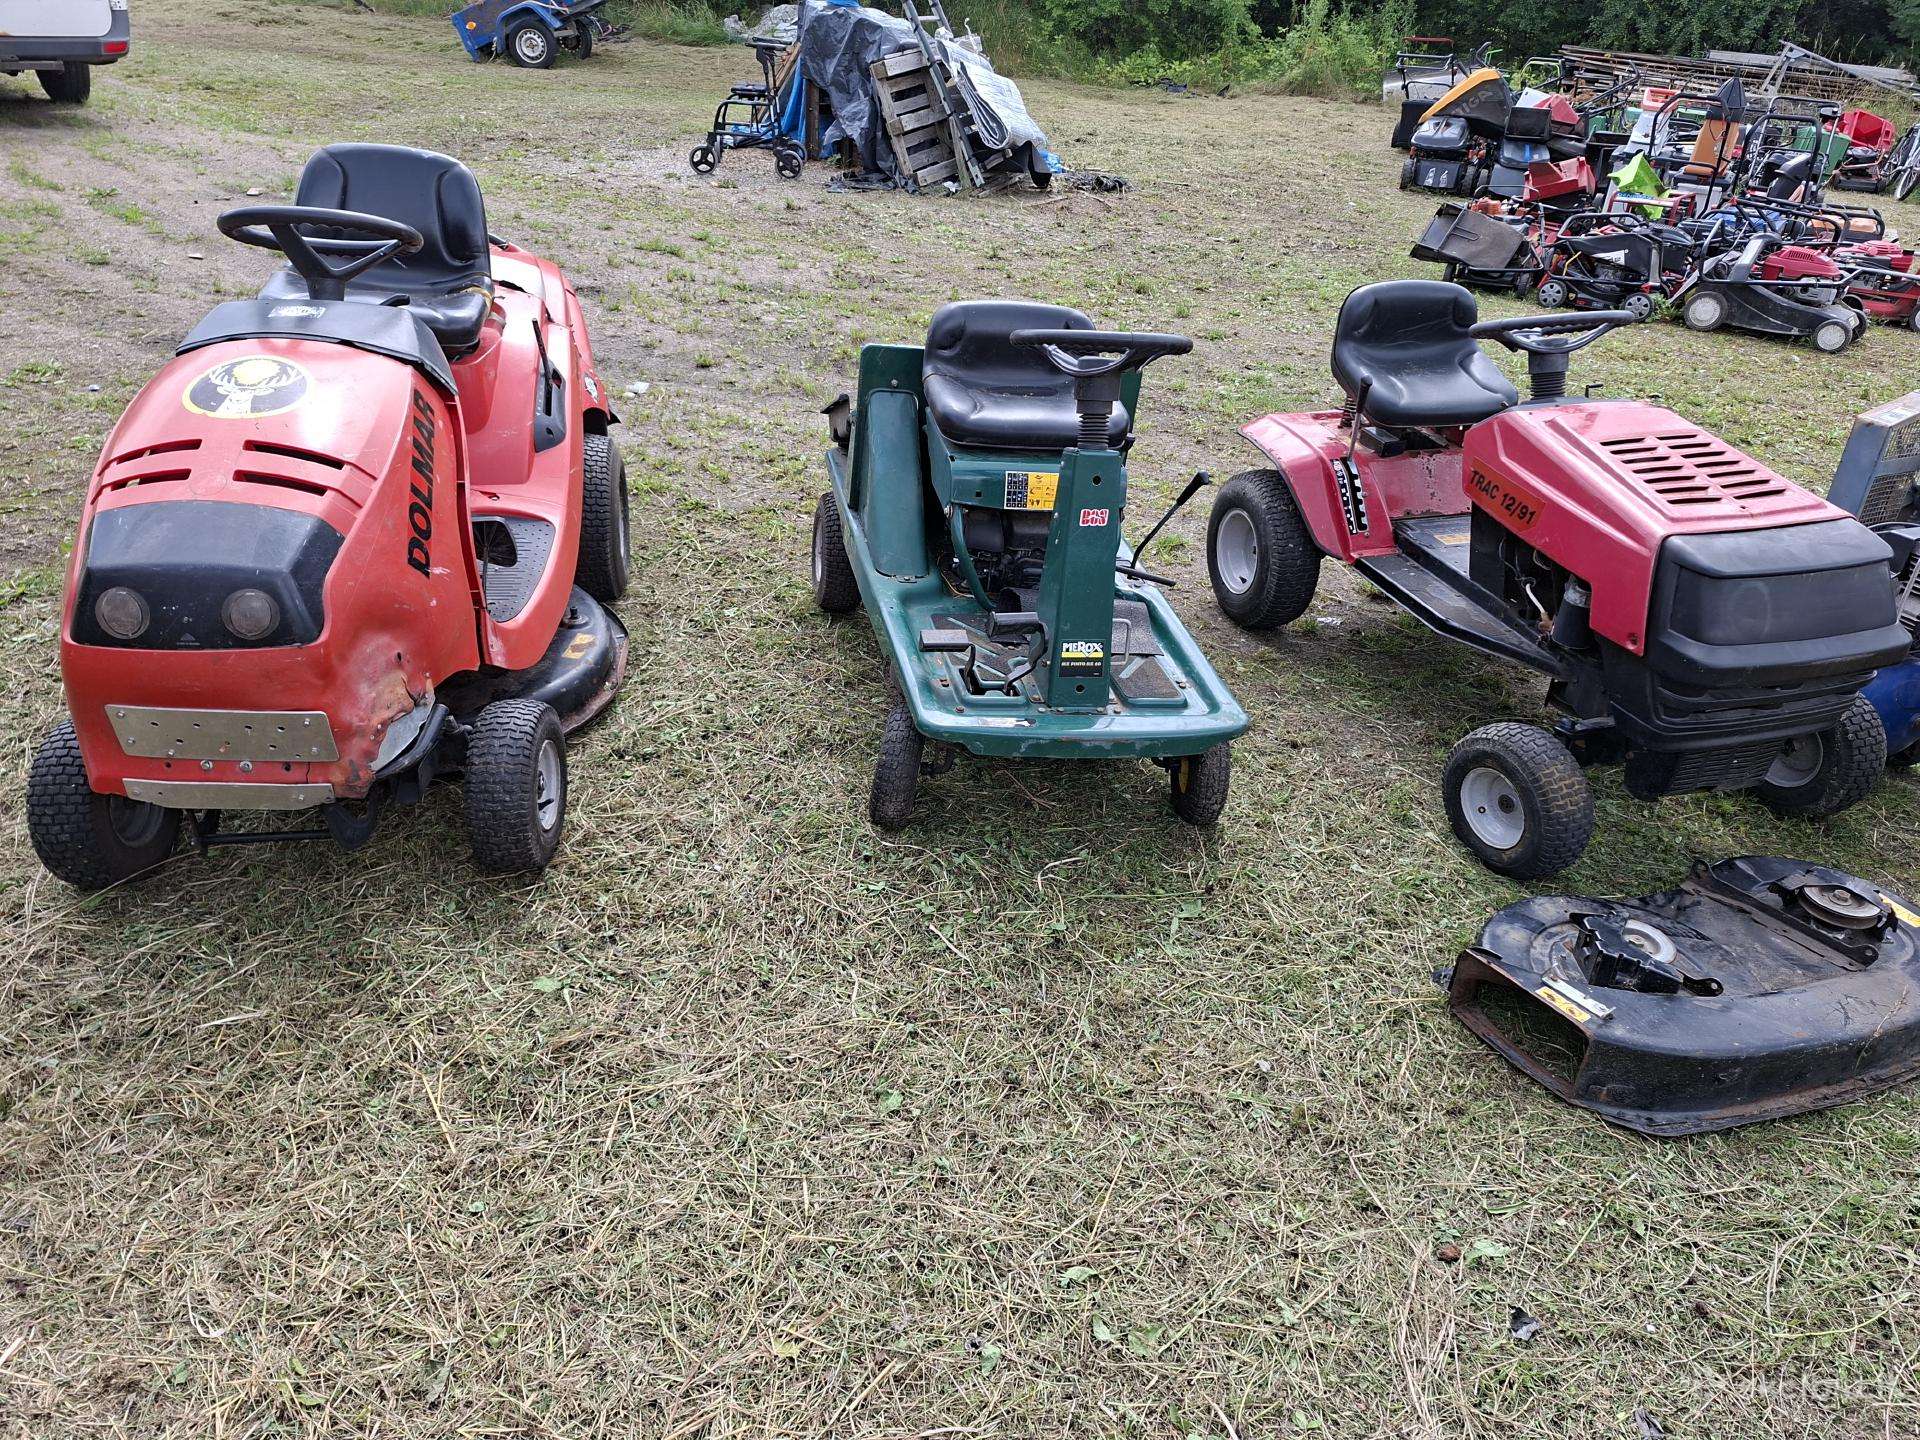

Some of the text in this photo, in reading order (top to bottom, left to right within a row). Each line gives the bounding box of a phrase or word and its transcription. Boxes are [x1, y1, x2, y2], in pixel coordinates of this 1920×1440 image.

[407, 389, 435, 580] DOLMAR
[1470, 470, 1537, 524] TRAC 12/91
[1062, 641, 1103, 655] MEROX
